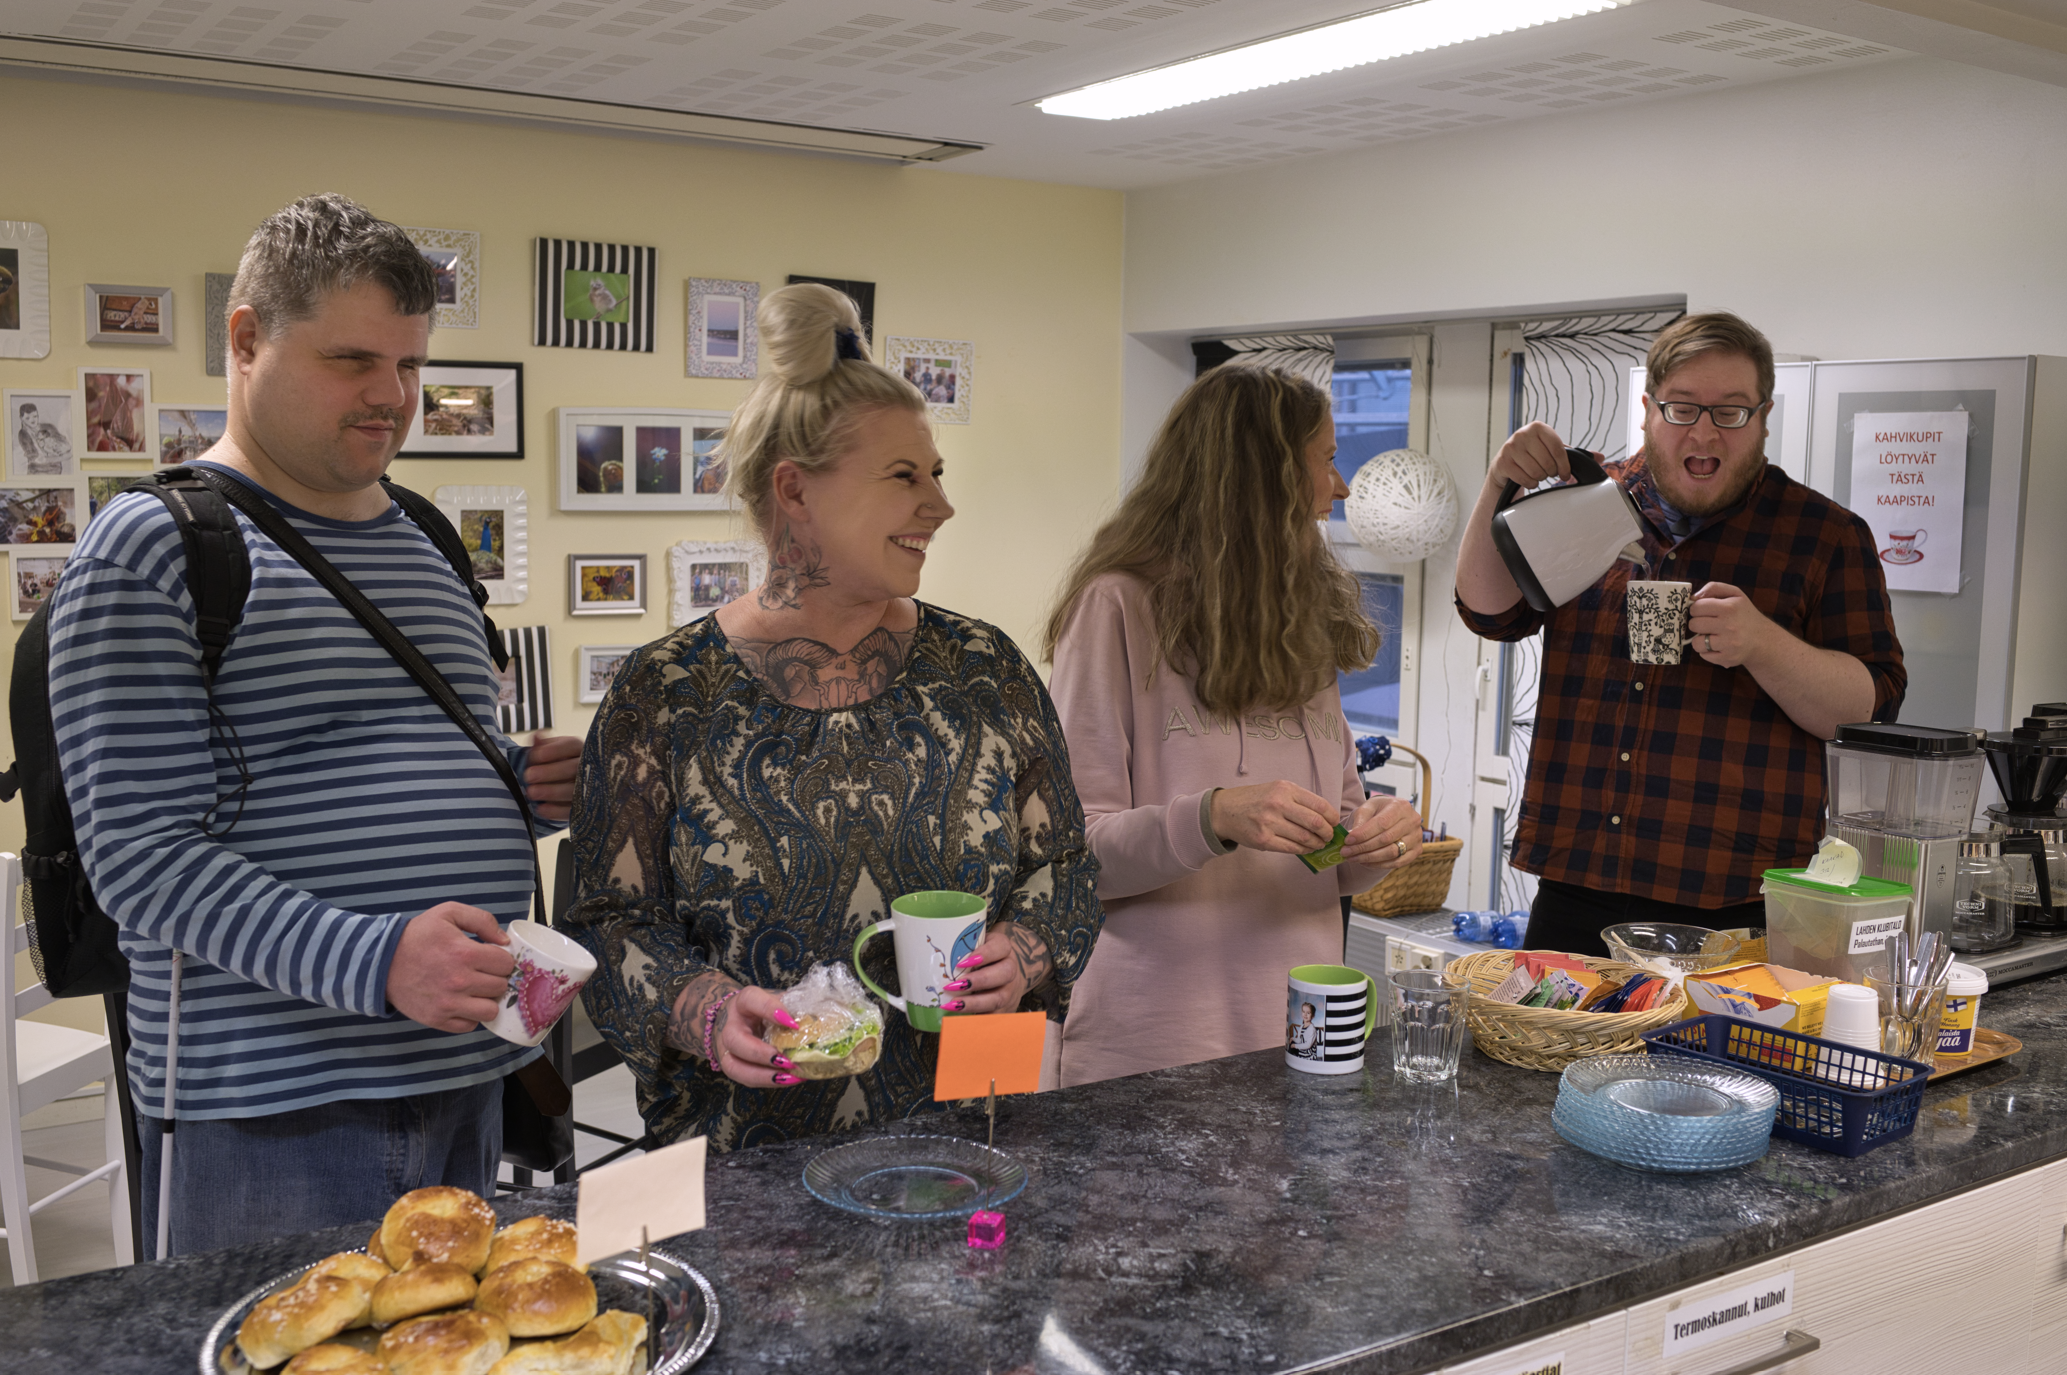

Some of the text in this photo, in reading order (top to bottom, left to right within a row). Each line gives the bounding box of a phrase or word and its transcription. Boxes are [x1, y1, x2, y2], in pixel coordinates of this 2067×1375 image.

[1875, 431, 1943, 443] KAHVIKUPIT
[1879, 451, 1937, 465] LÖYTYVÄT
[1889, 471, 1924, 485] TÄSTÄ
[1877, 495, 1935, 507] KAAPISTA!
[1856, 924, 1876, 936] LAHDEN
[1998, 962, 2034, 975] MOCCAMASTER
[1937, 1029, 1961, 1037] alaista
[1673, 1287, 1786, 1341] Termoskannut, kulhot
